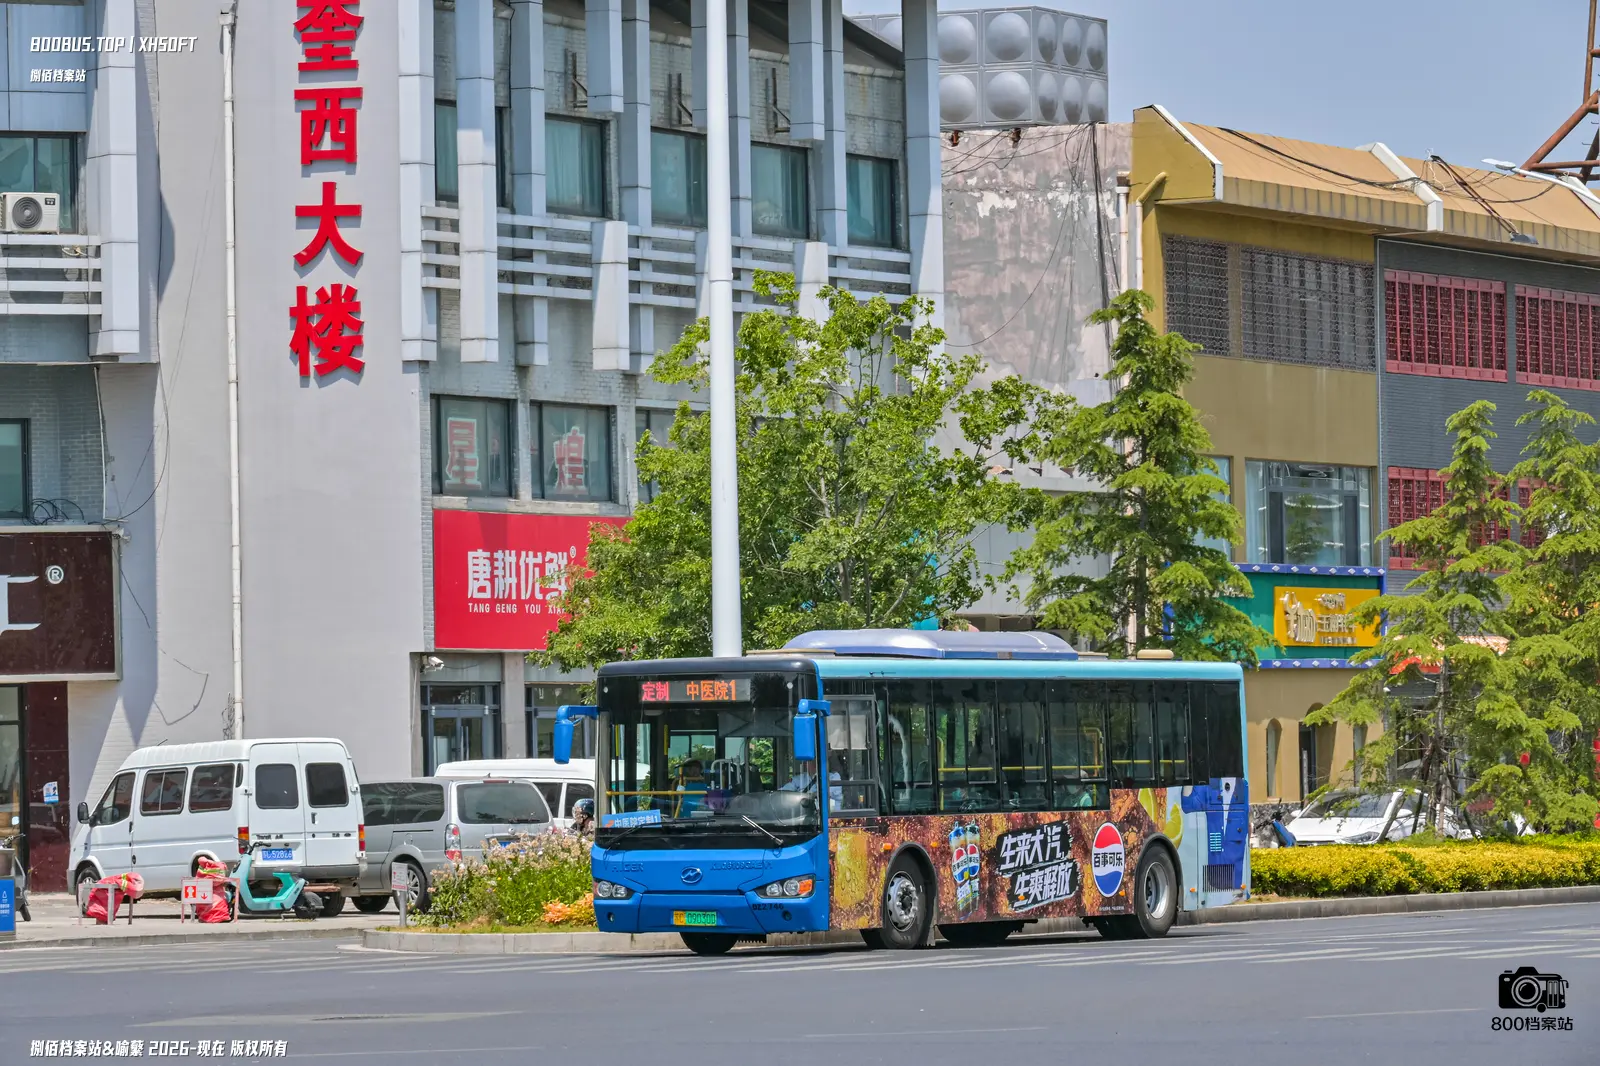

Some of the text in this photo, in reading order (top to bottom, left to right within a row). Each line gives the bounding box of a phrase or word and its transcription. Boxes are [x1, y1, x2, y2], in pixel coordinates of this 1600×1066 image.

[467, 549, 568, 600] 唐耕优鲜
[468, 603, 566, 614] TANG GENG YOU XIA
[641, 679, 736, 702] 定制 中医院1
[1093, 852, 1123, 868] 百事可乐
[1013, 861, 1074, 908] 生爽释放
